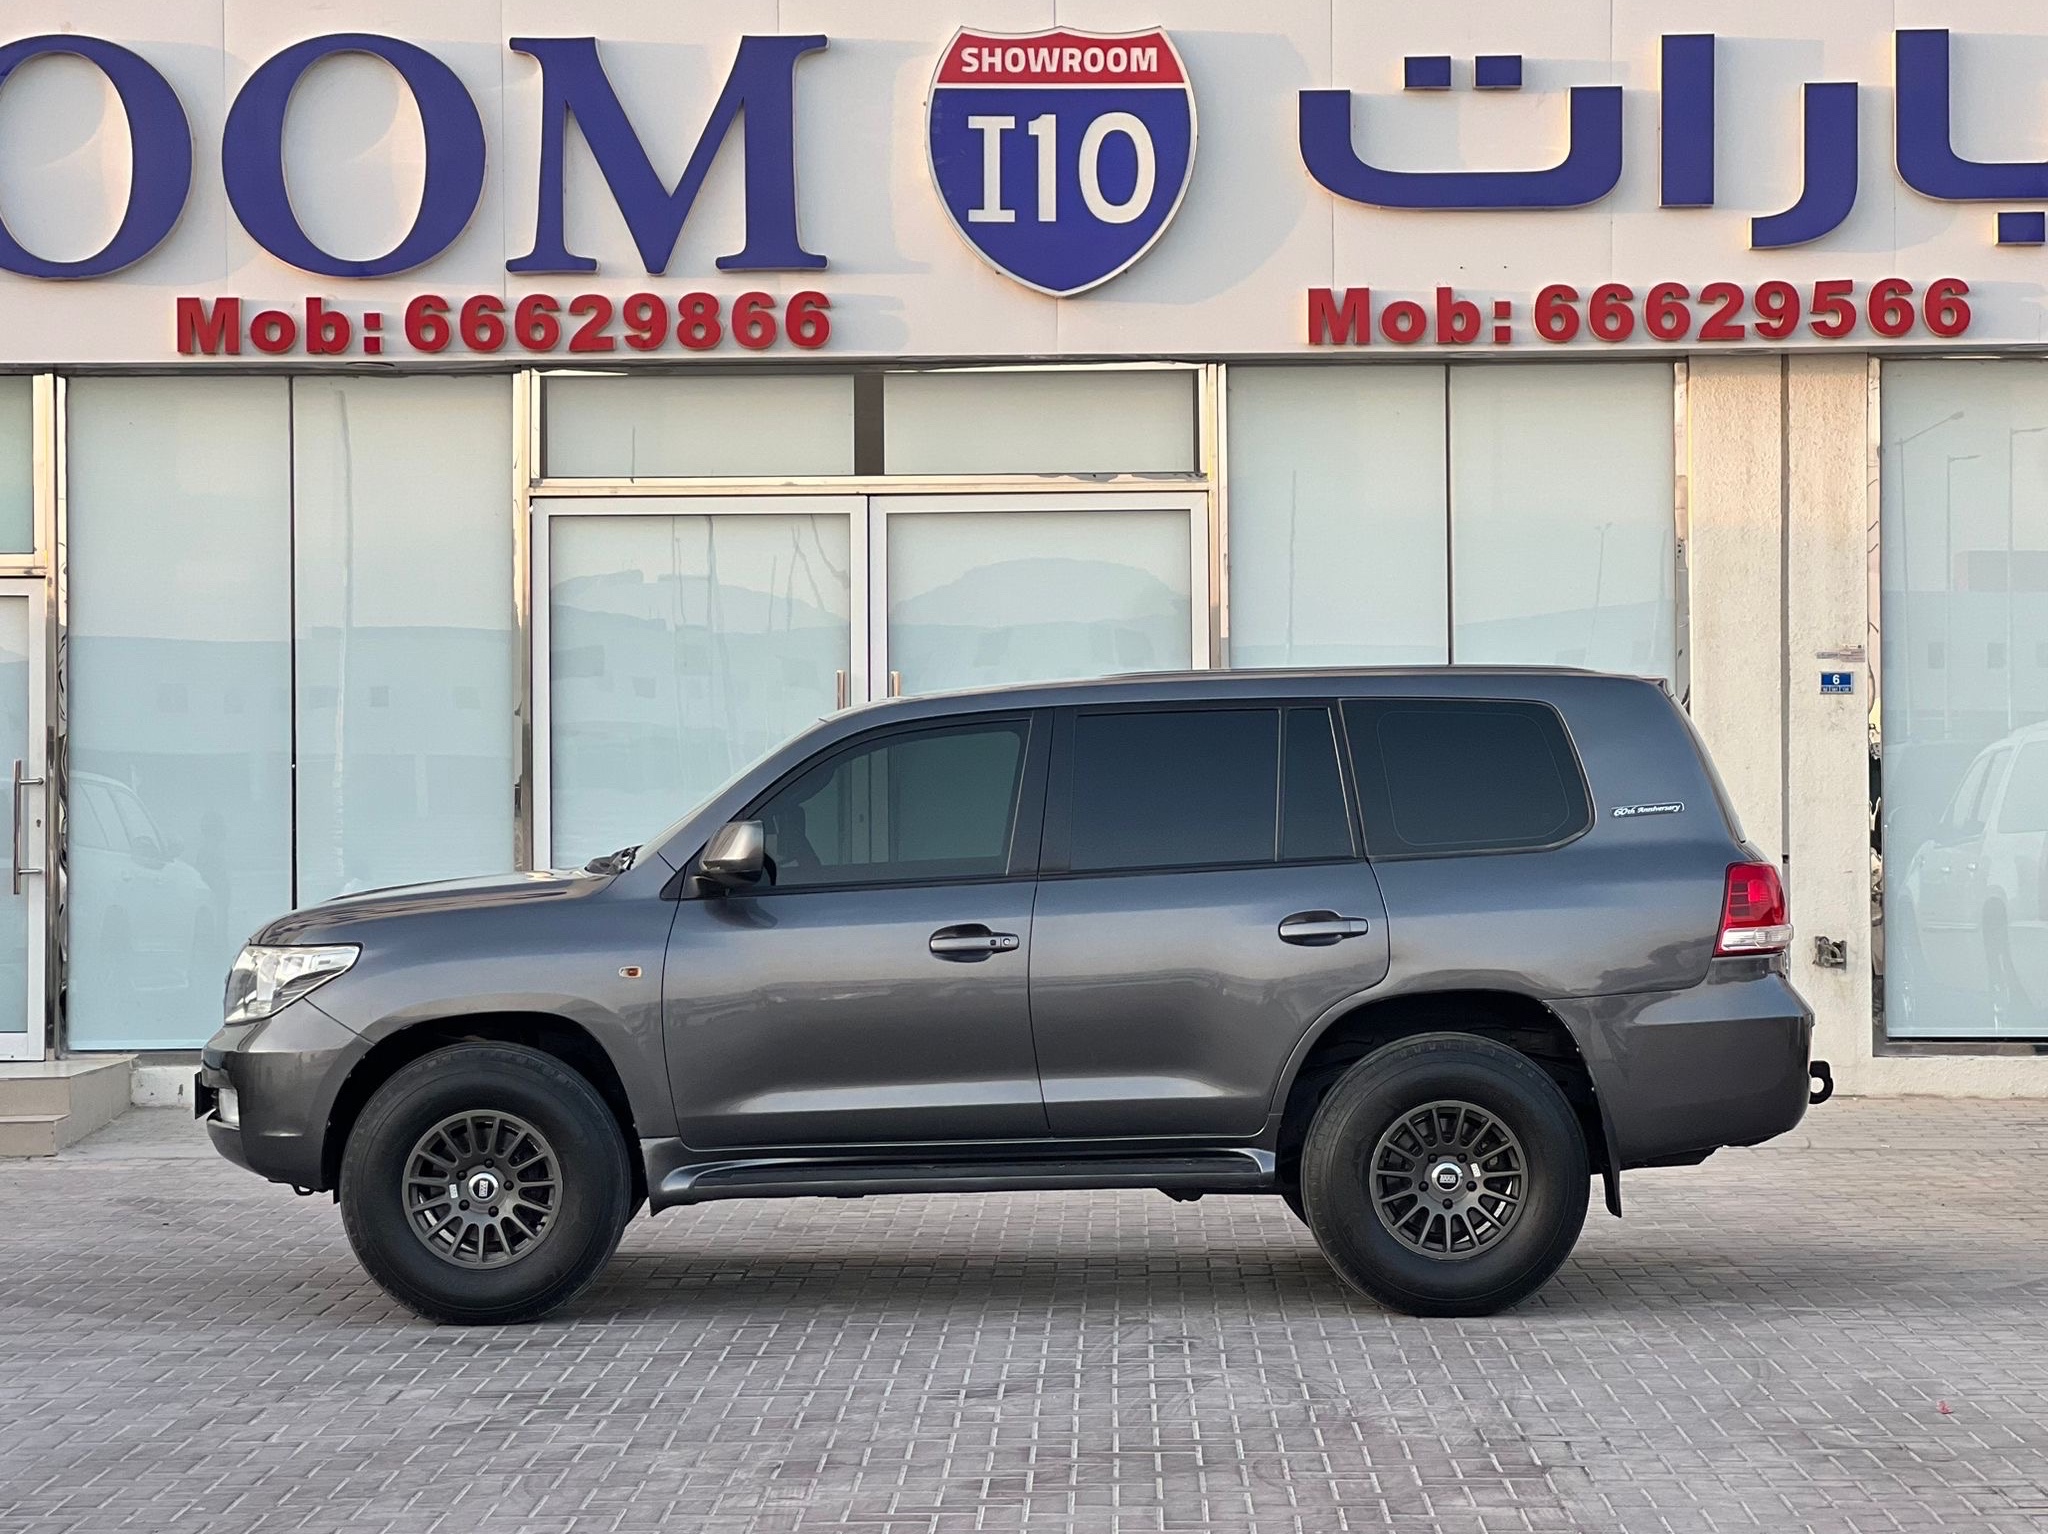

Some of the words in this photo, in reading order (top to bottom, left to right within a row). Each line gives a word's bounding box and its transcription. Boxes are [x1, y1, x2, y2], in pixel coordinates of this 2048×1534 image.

[961, 46, 1158, 73] SHOWROOM
[967, 111, 1156, 224] I10
[404, 291, 831, 352] 66629866
[1533, 278, 1972, 343] 66629566
[1832, 674, 1840, 685] 6
[1613, 806, 1635, 816] 60th
[1637, 804, 1681, 813] Anniversary
